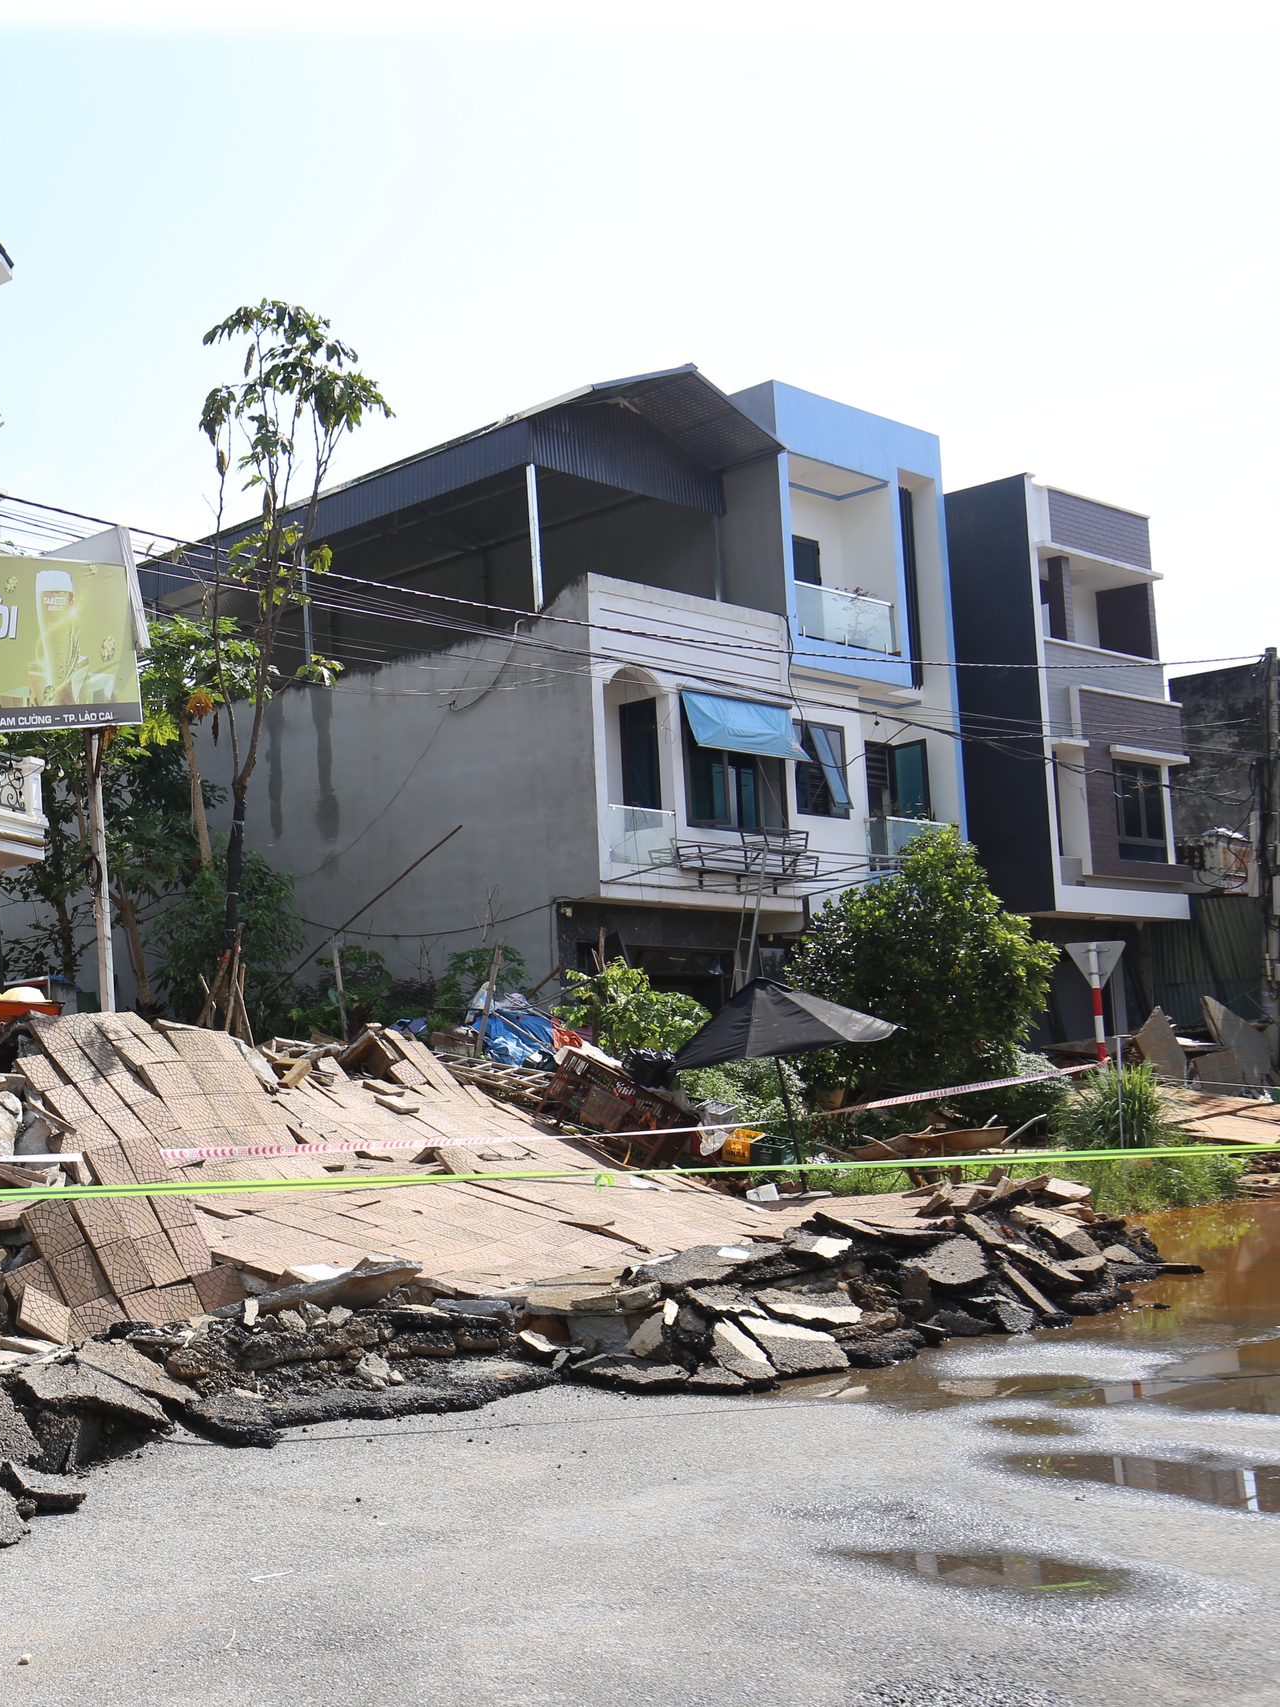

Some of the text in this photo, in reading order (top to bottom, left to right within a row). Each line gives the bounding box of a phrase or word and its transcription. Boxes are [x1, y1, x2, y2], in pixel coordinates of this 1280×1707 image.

[17, 714, 52, 726] CƯỜNG
[79, 711, 97, 722] LÀO
[98, 712, 113, 721] CAI
